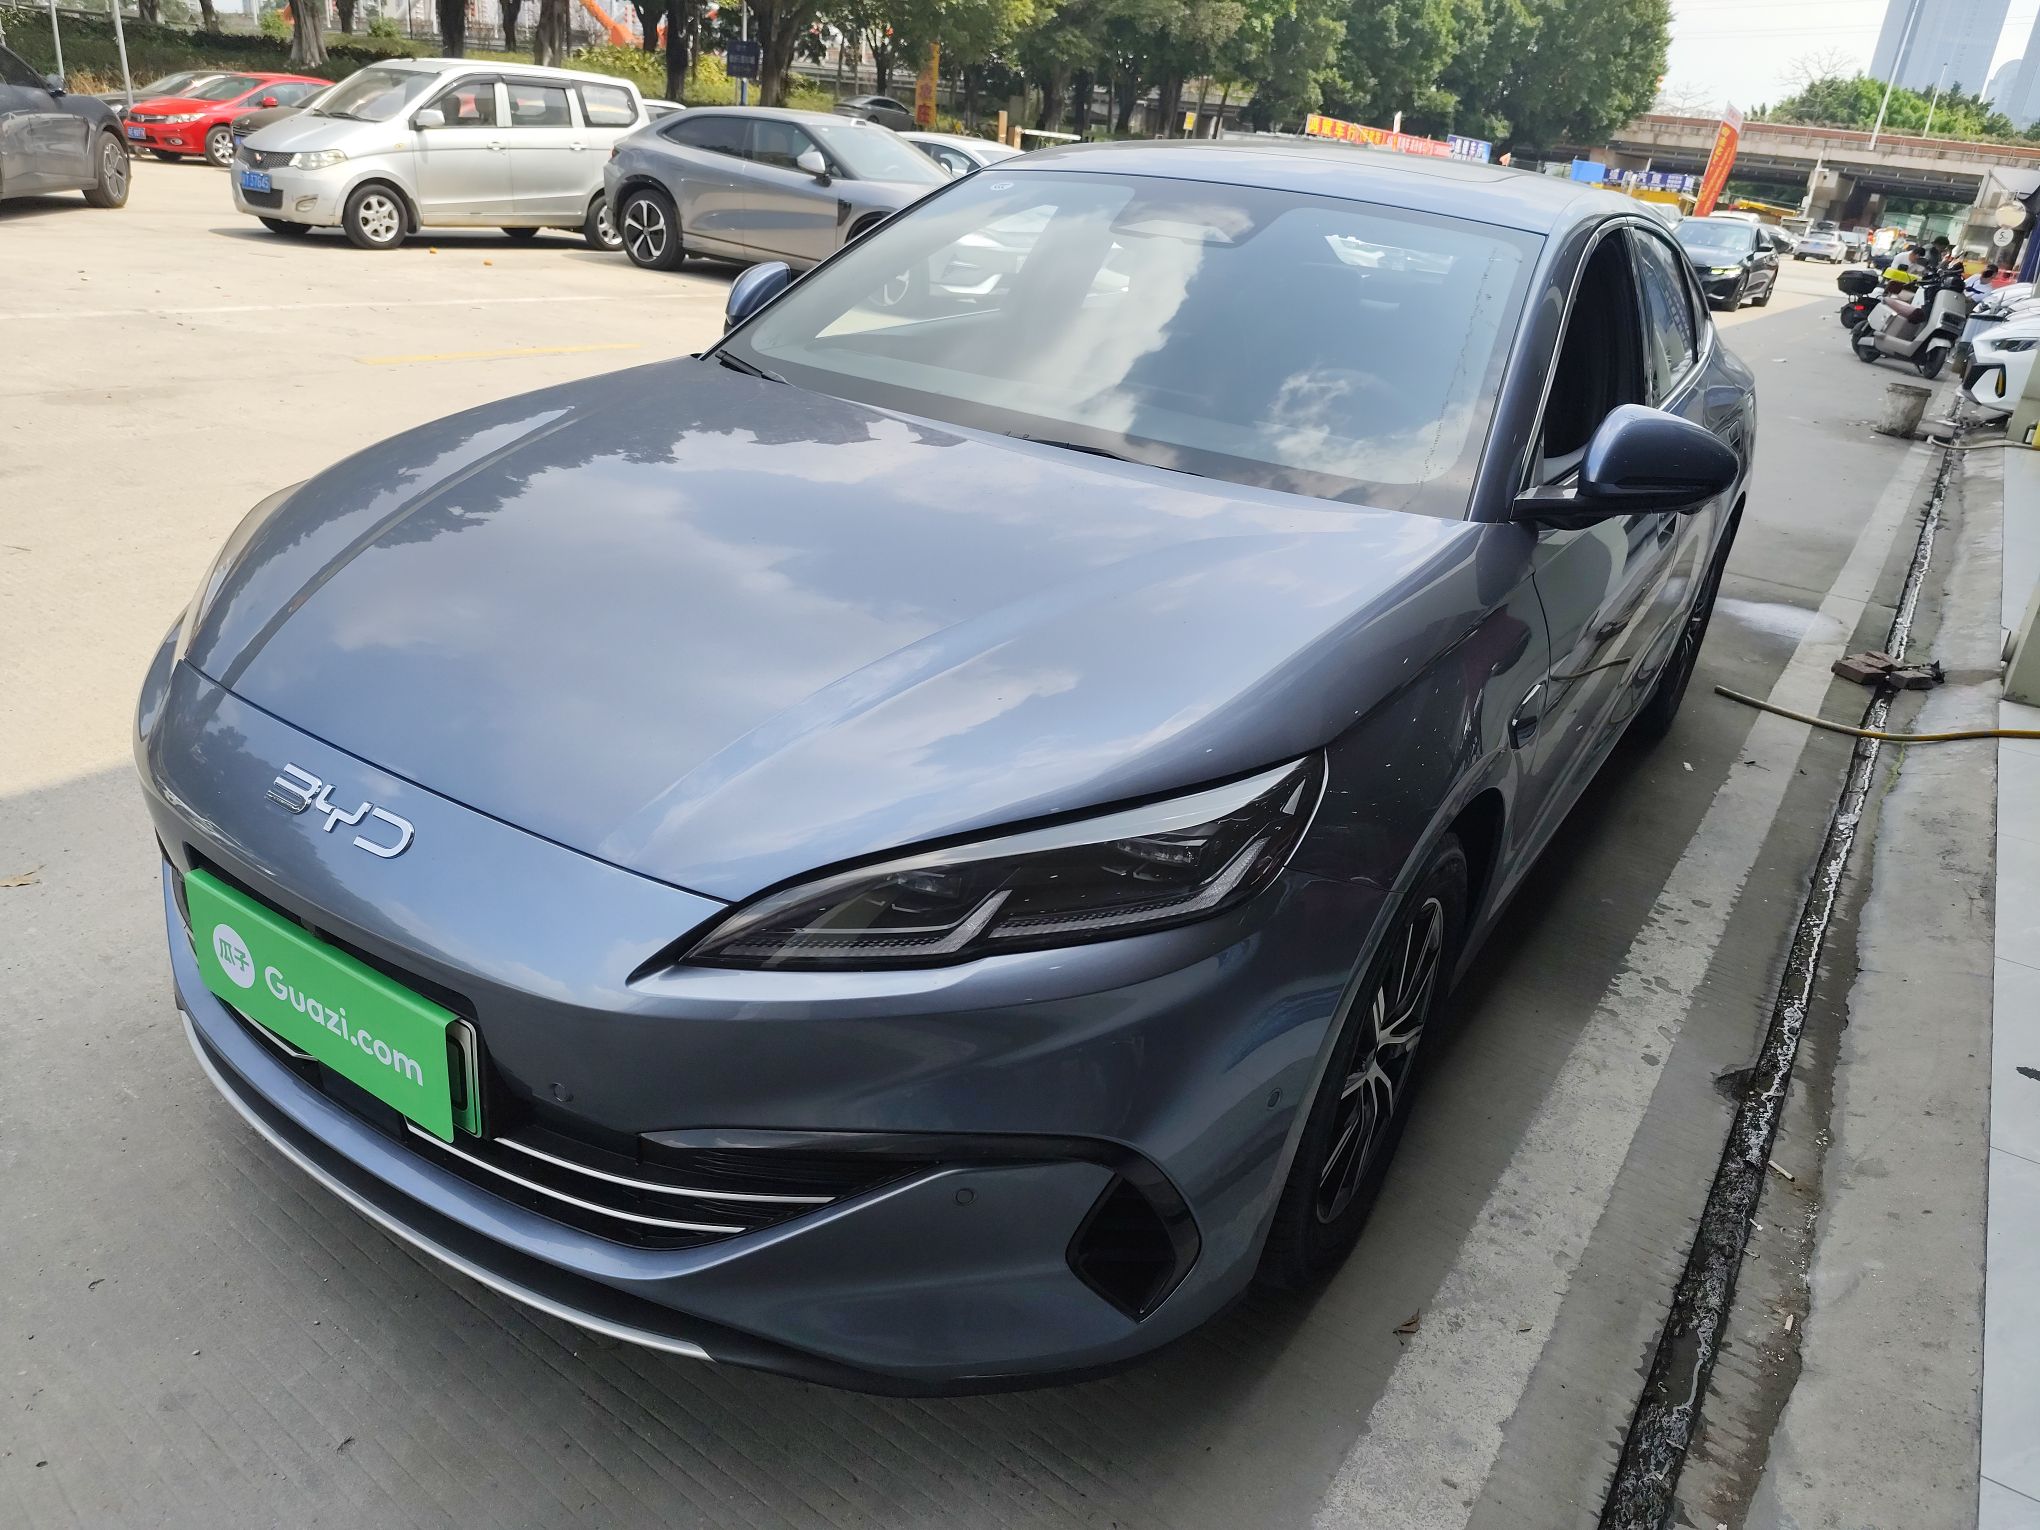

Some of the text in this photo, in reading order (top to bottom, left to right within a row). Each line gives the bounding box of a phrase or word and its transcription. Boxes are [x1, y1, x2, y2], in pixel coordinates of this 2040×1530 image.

[265, 761, 415, 859] BYD
[218, 936, 250, 973] 瓜子
[265, 966, 423, 1086] Guazi.com
